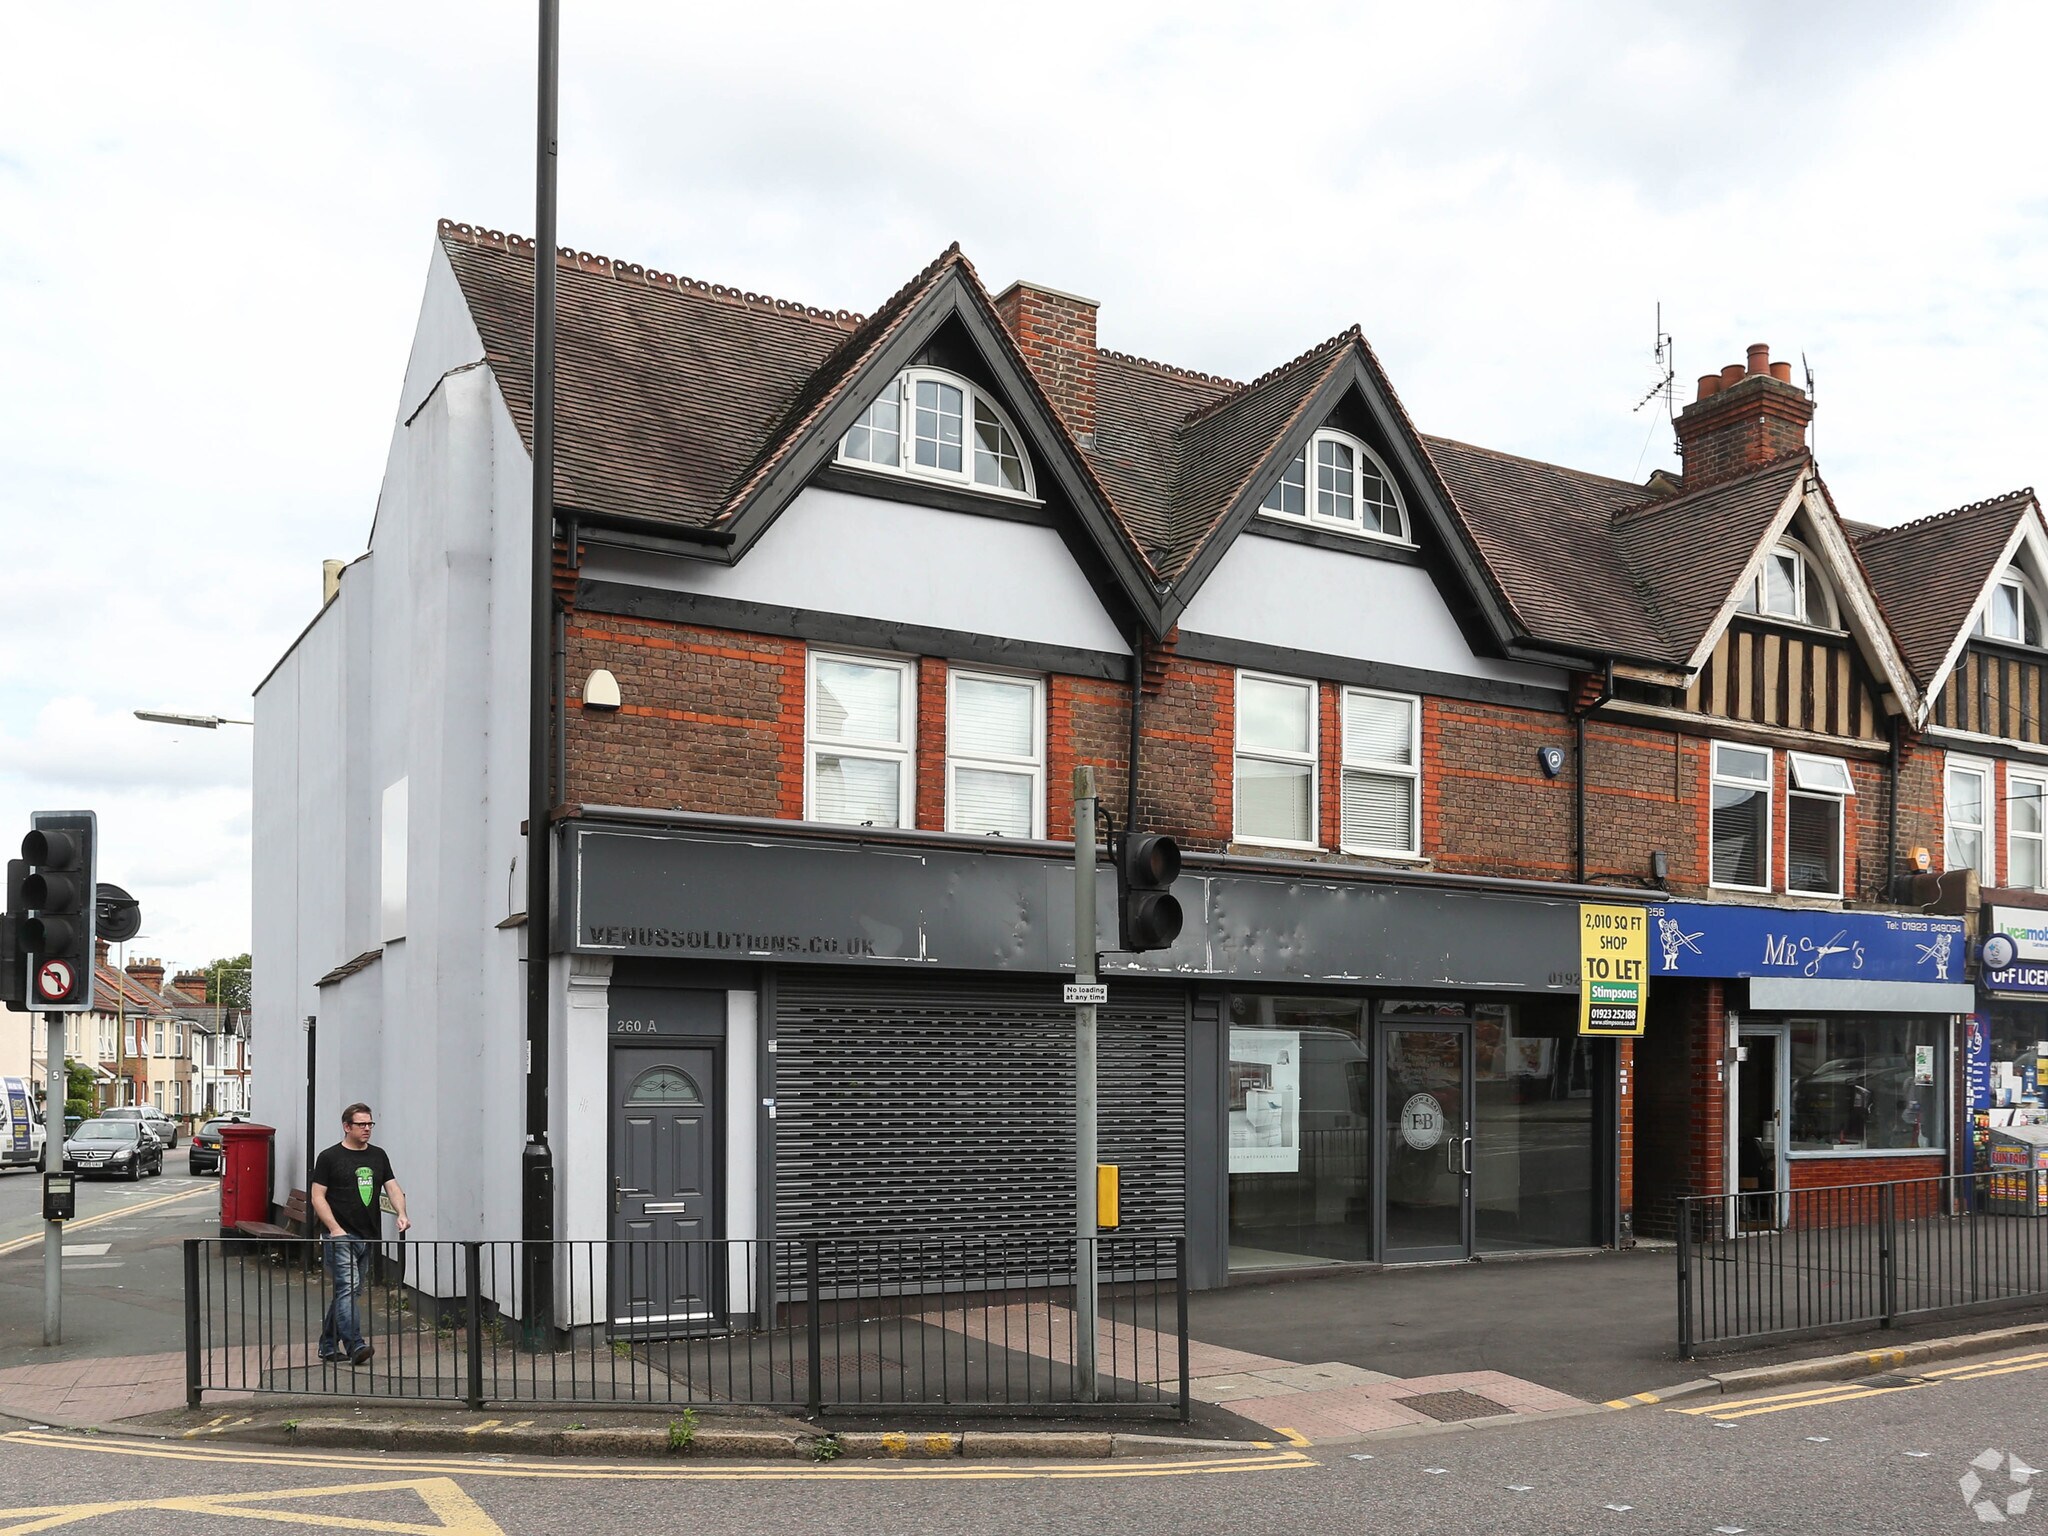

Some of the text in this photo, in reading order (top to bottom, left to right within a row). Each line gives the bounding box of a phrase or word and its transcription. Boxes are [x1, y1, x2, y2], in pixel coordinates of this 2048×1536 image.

[1649, 907, 1665, 917] 256
[1585, 913, 1642, 931] 2,010 SQ FT
[1886, 920, 1899, 930] Tel:
[1901, 921, 1928, 932] 01923
[589, 925, 877, 957] VENUSSOLUTIONS.CO.UK
[1600, 935, 1628, 950] SHOP
[1586, 957, 1642, 981] TO LET
[1992, 967, 2017, 984] OFF
[1075, 994, 1088, 1002] any
[1089, 993, 1105, 1001] time
[1079, 986, 1105, 995] loading
[1592, 985, 1637, 1002] Stimpsons
[1591, 1008, 1636, 1020] 01923 252188
[617, 1019, 657, 1033] 260 A
[1591, 1019, 1636, 1027] www.stimpsons.co.uk
[52, 1071, 59, 1080] 5
[1412, 1113, 1434, 1130] F&B
